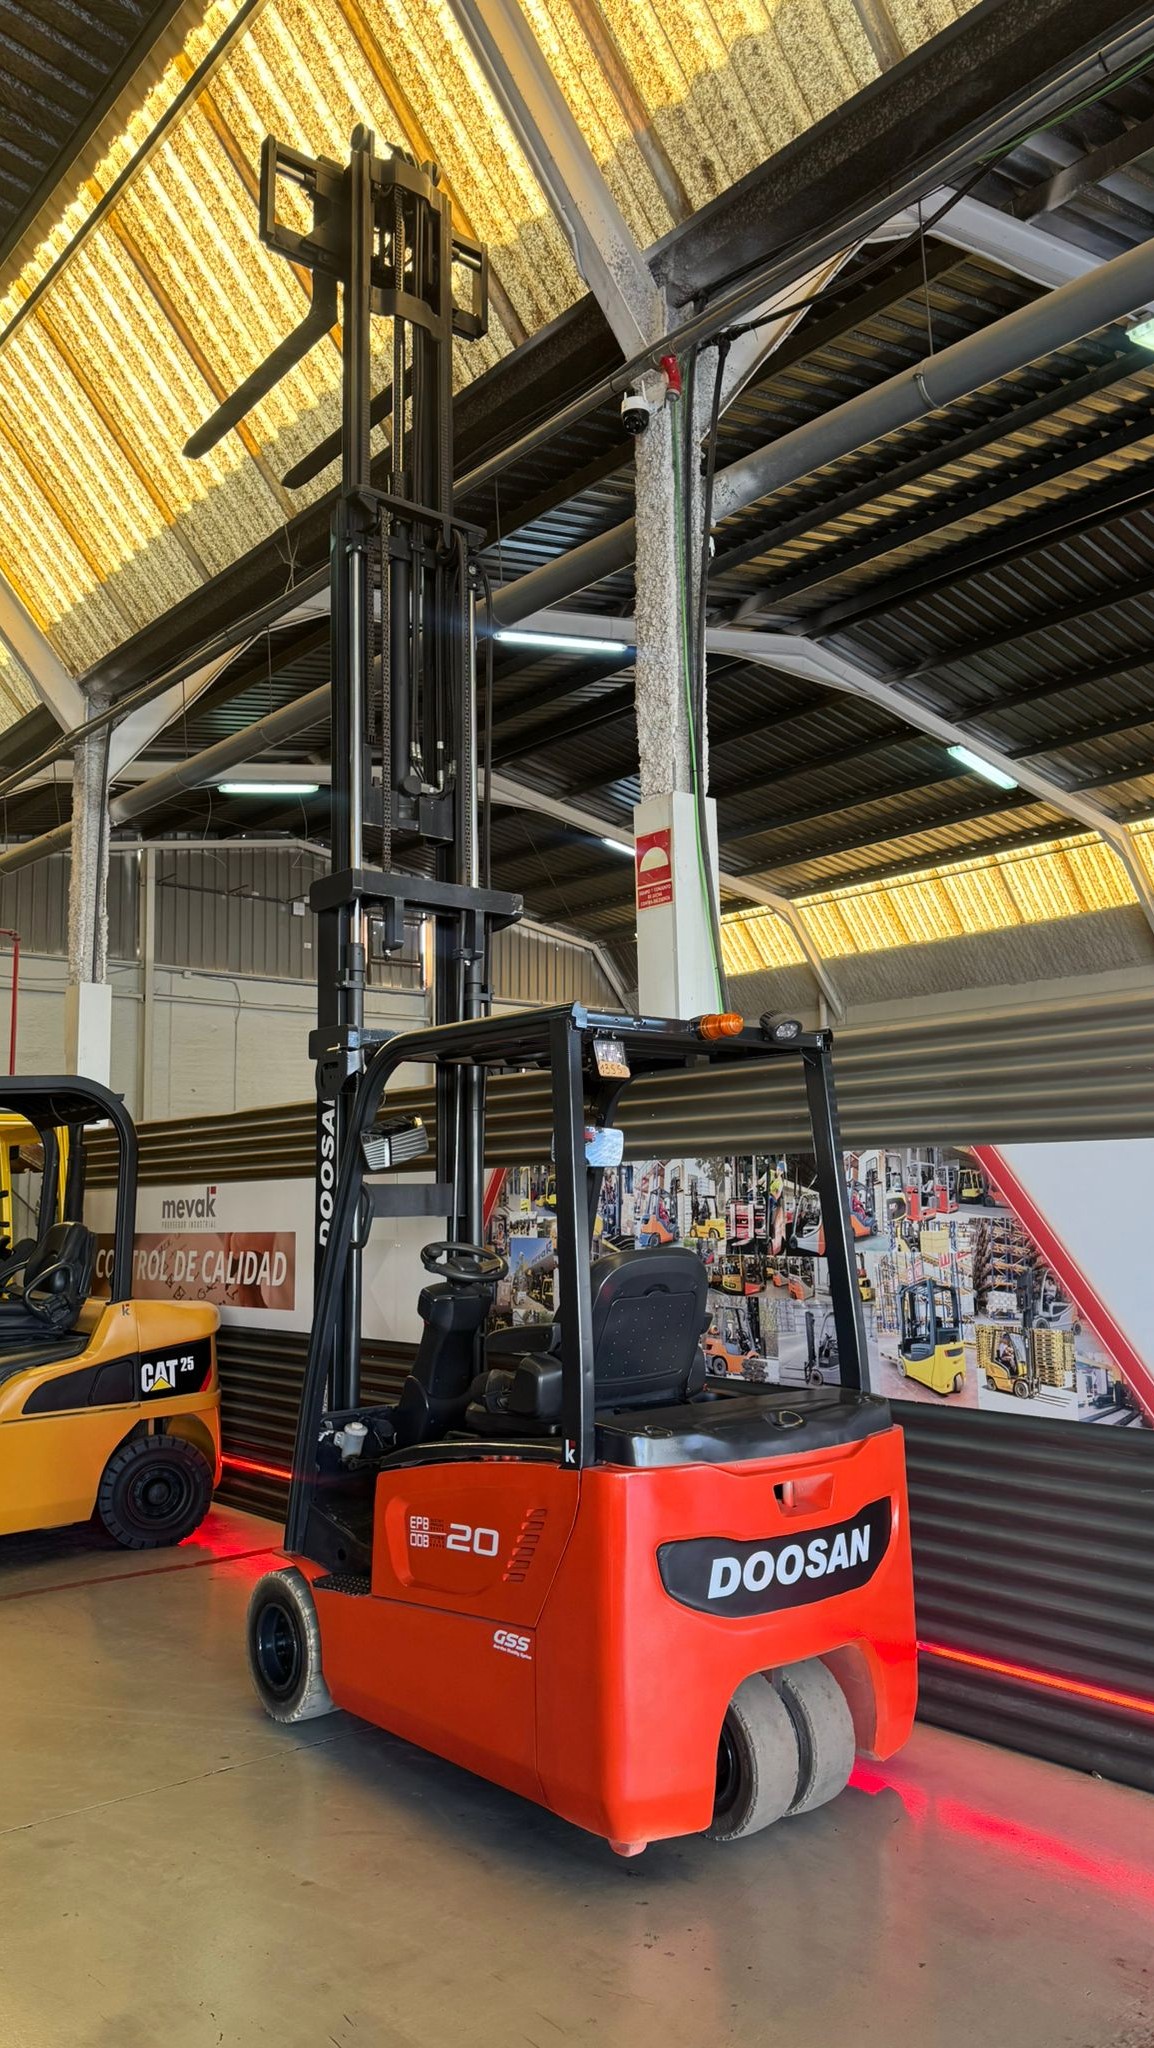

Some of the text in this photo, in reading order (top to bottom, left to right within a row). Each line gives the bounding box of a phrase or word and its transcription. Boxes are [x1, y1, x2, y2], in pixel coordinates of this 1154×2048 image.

[319, 1099, 336, 1247] DOOSA
[162, 1186, 217, 1219] mevak
[95, 1249, 288, 1287] COTROL DE CALIDAD
[141, 1356, 195, 1393] CAT 25
[446, 1522, 500, 1557] 20
[707, 1524, 871, 1600] DOOSAN
[493, 1629, 531, 1652] GSS
